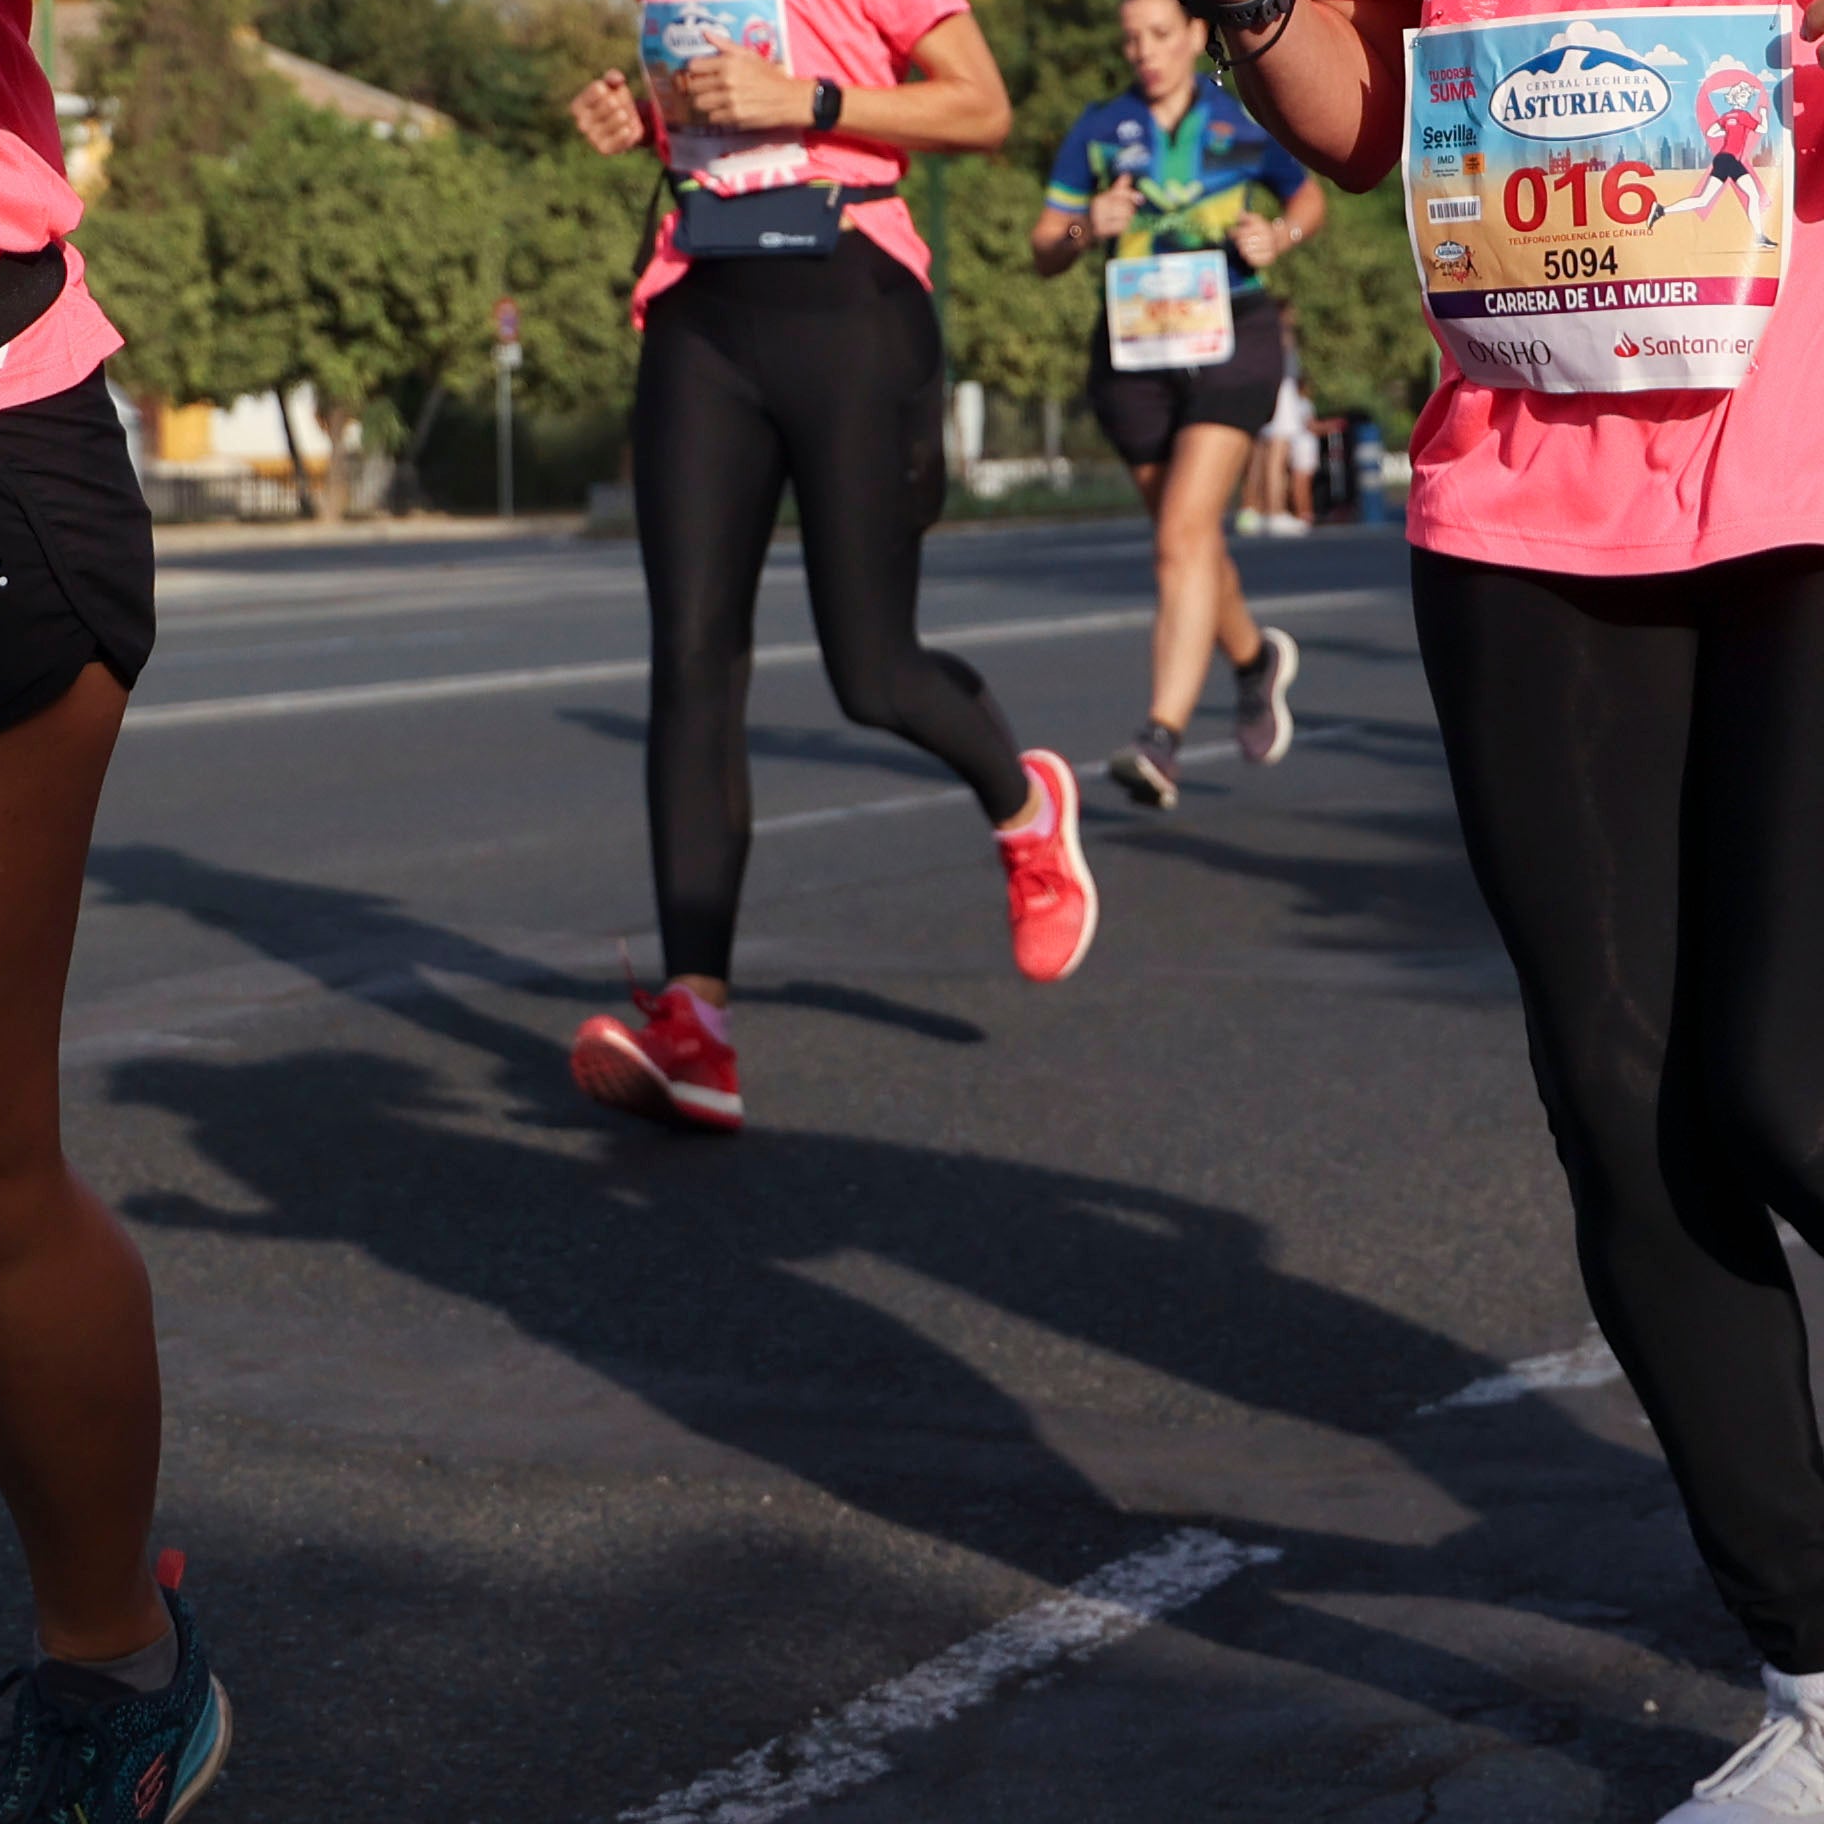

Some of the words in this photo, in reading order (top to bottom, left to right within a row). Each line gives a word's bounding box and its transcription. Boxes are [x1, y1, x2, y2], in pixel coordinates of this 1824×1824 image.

[1430, 80, 1476, 103] SUMA
[1526, 79, 1580, 91] CENTRAL
[1586, 76, 1649, 86] LECHERA
[1502, 86, 1656, 122] ASTURIANA
[1437, 155, 1454, 165] IMD
[1503, 160, 1658, 232] 016
[1509, 235, 1551, 245] TELÉFONO
[1553, 231, 1598, 243] VIOLENCIA
[1599, 230, 1610, 238] DE
[1612, 228, 1654, 238] GÉNERO
[1544, 245, 1618, 280] 5094
[1485, 293, 1560, 315] CARRERA
[1565, 287, 1589, 309] DE
[1594, 285, 1618, 307] LA
[1624, 281, 1698, 305] MUJER
[1468, 339, 1551, 366] OYSHO
